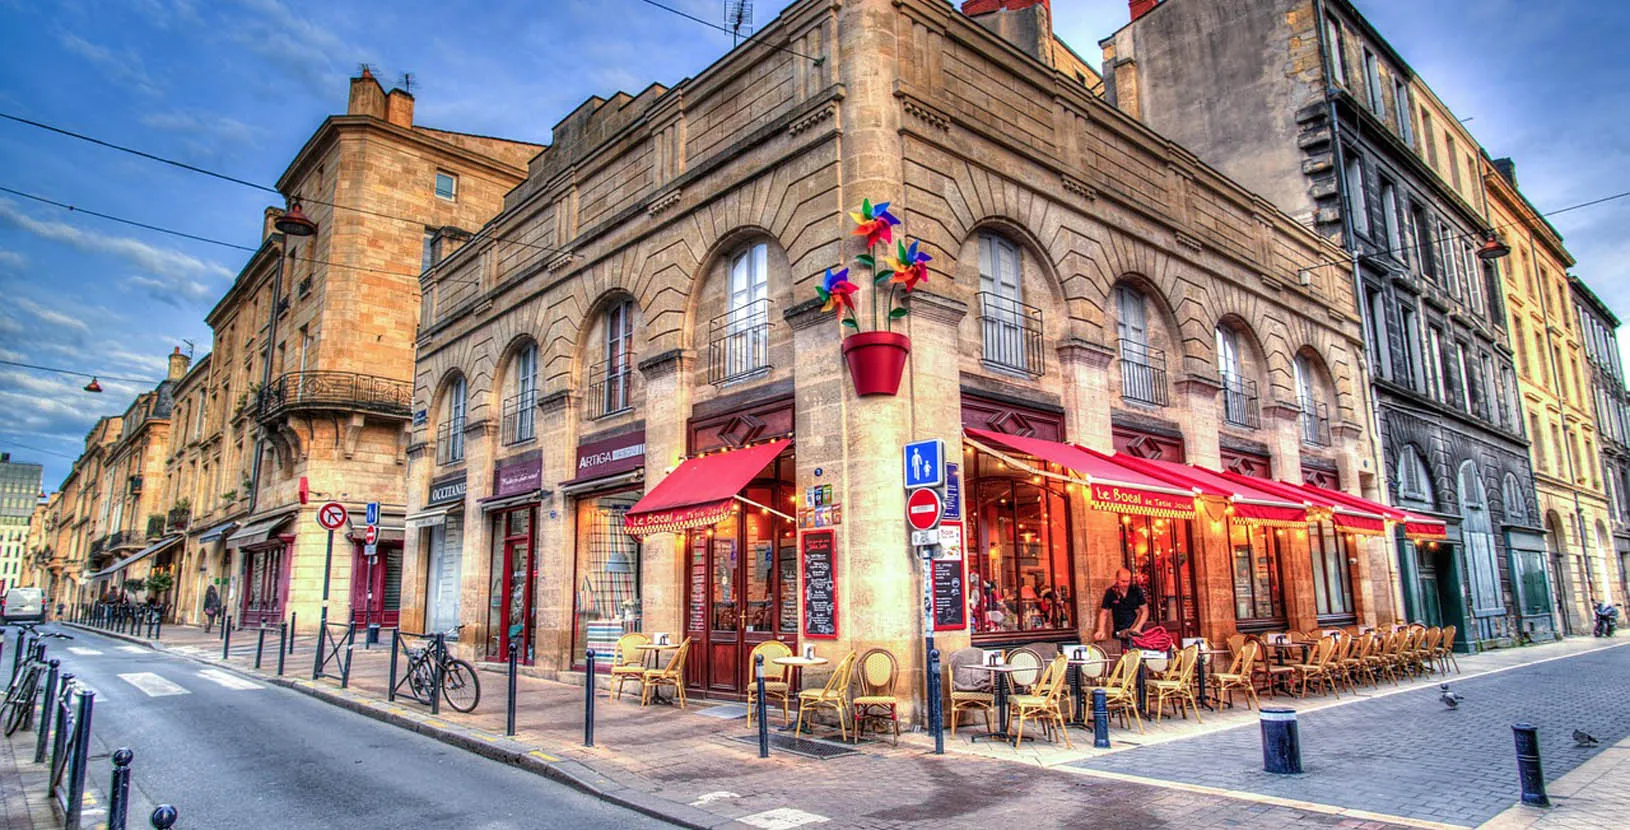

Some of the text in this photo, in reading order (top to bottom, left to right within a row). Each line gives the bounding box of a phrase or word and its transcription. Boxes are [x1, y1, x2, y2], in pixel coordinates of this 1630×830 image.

[579, 452, 612, 469] ARTIGA
[1096, 487, 1110, 500] Le
[1113, 488, 1141, 504] Bocal
[633, 516, 644, 526] Le
[647, 512, 673, 525] Bocal
